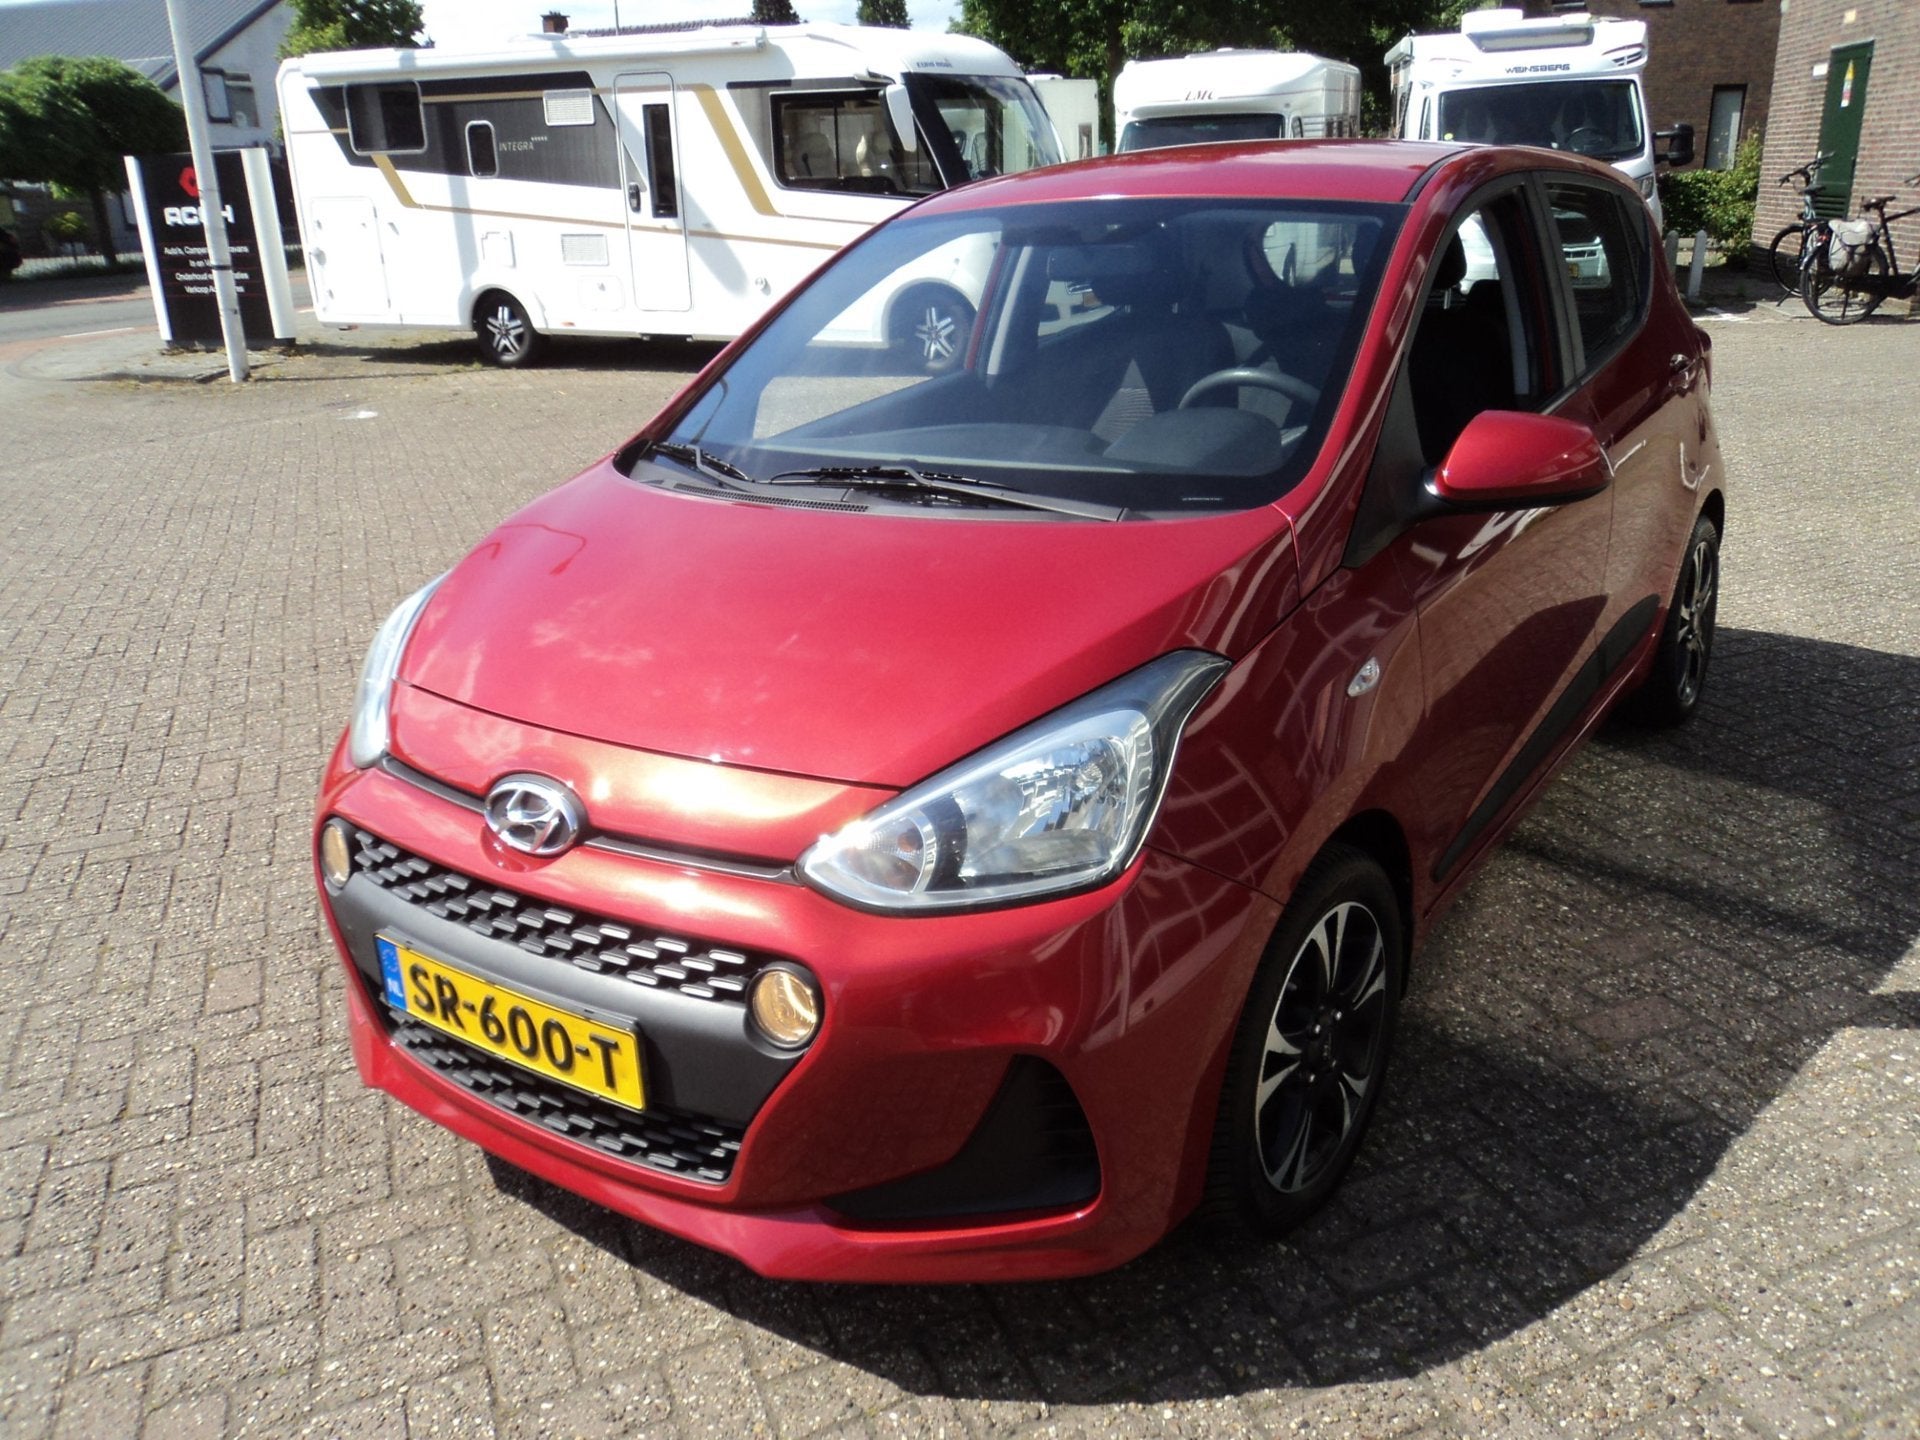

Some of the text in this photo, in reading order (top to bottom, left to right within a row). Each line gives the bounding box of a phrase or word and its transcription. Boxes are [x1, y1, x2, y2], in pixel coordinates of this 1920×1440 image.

[1505, 63, 1571, 74] WEINSBERG
[499, 141, 535, 151] INTEGRA
[387, 978, 403, 997] NL
[410, 963, 619, 1088] SR-600-T
